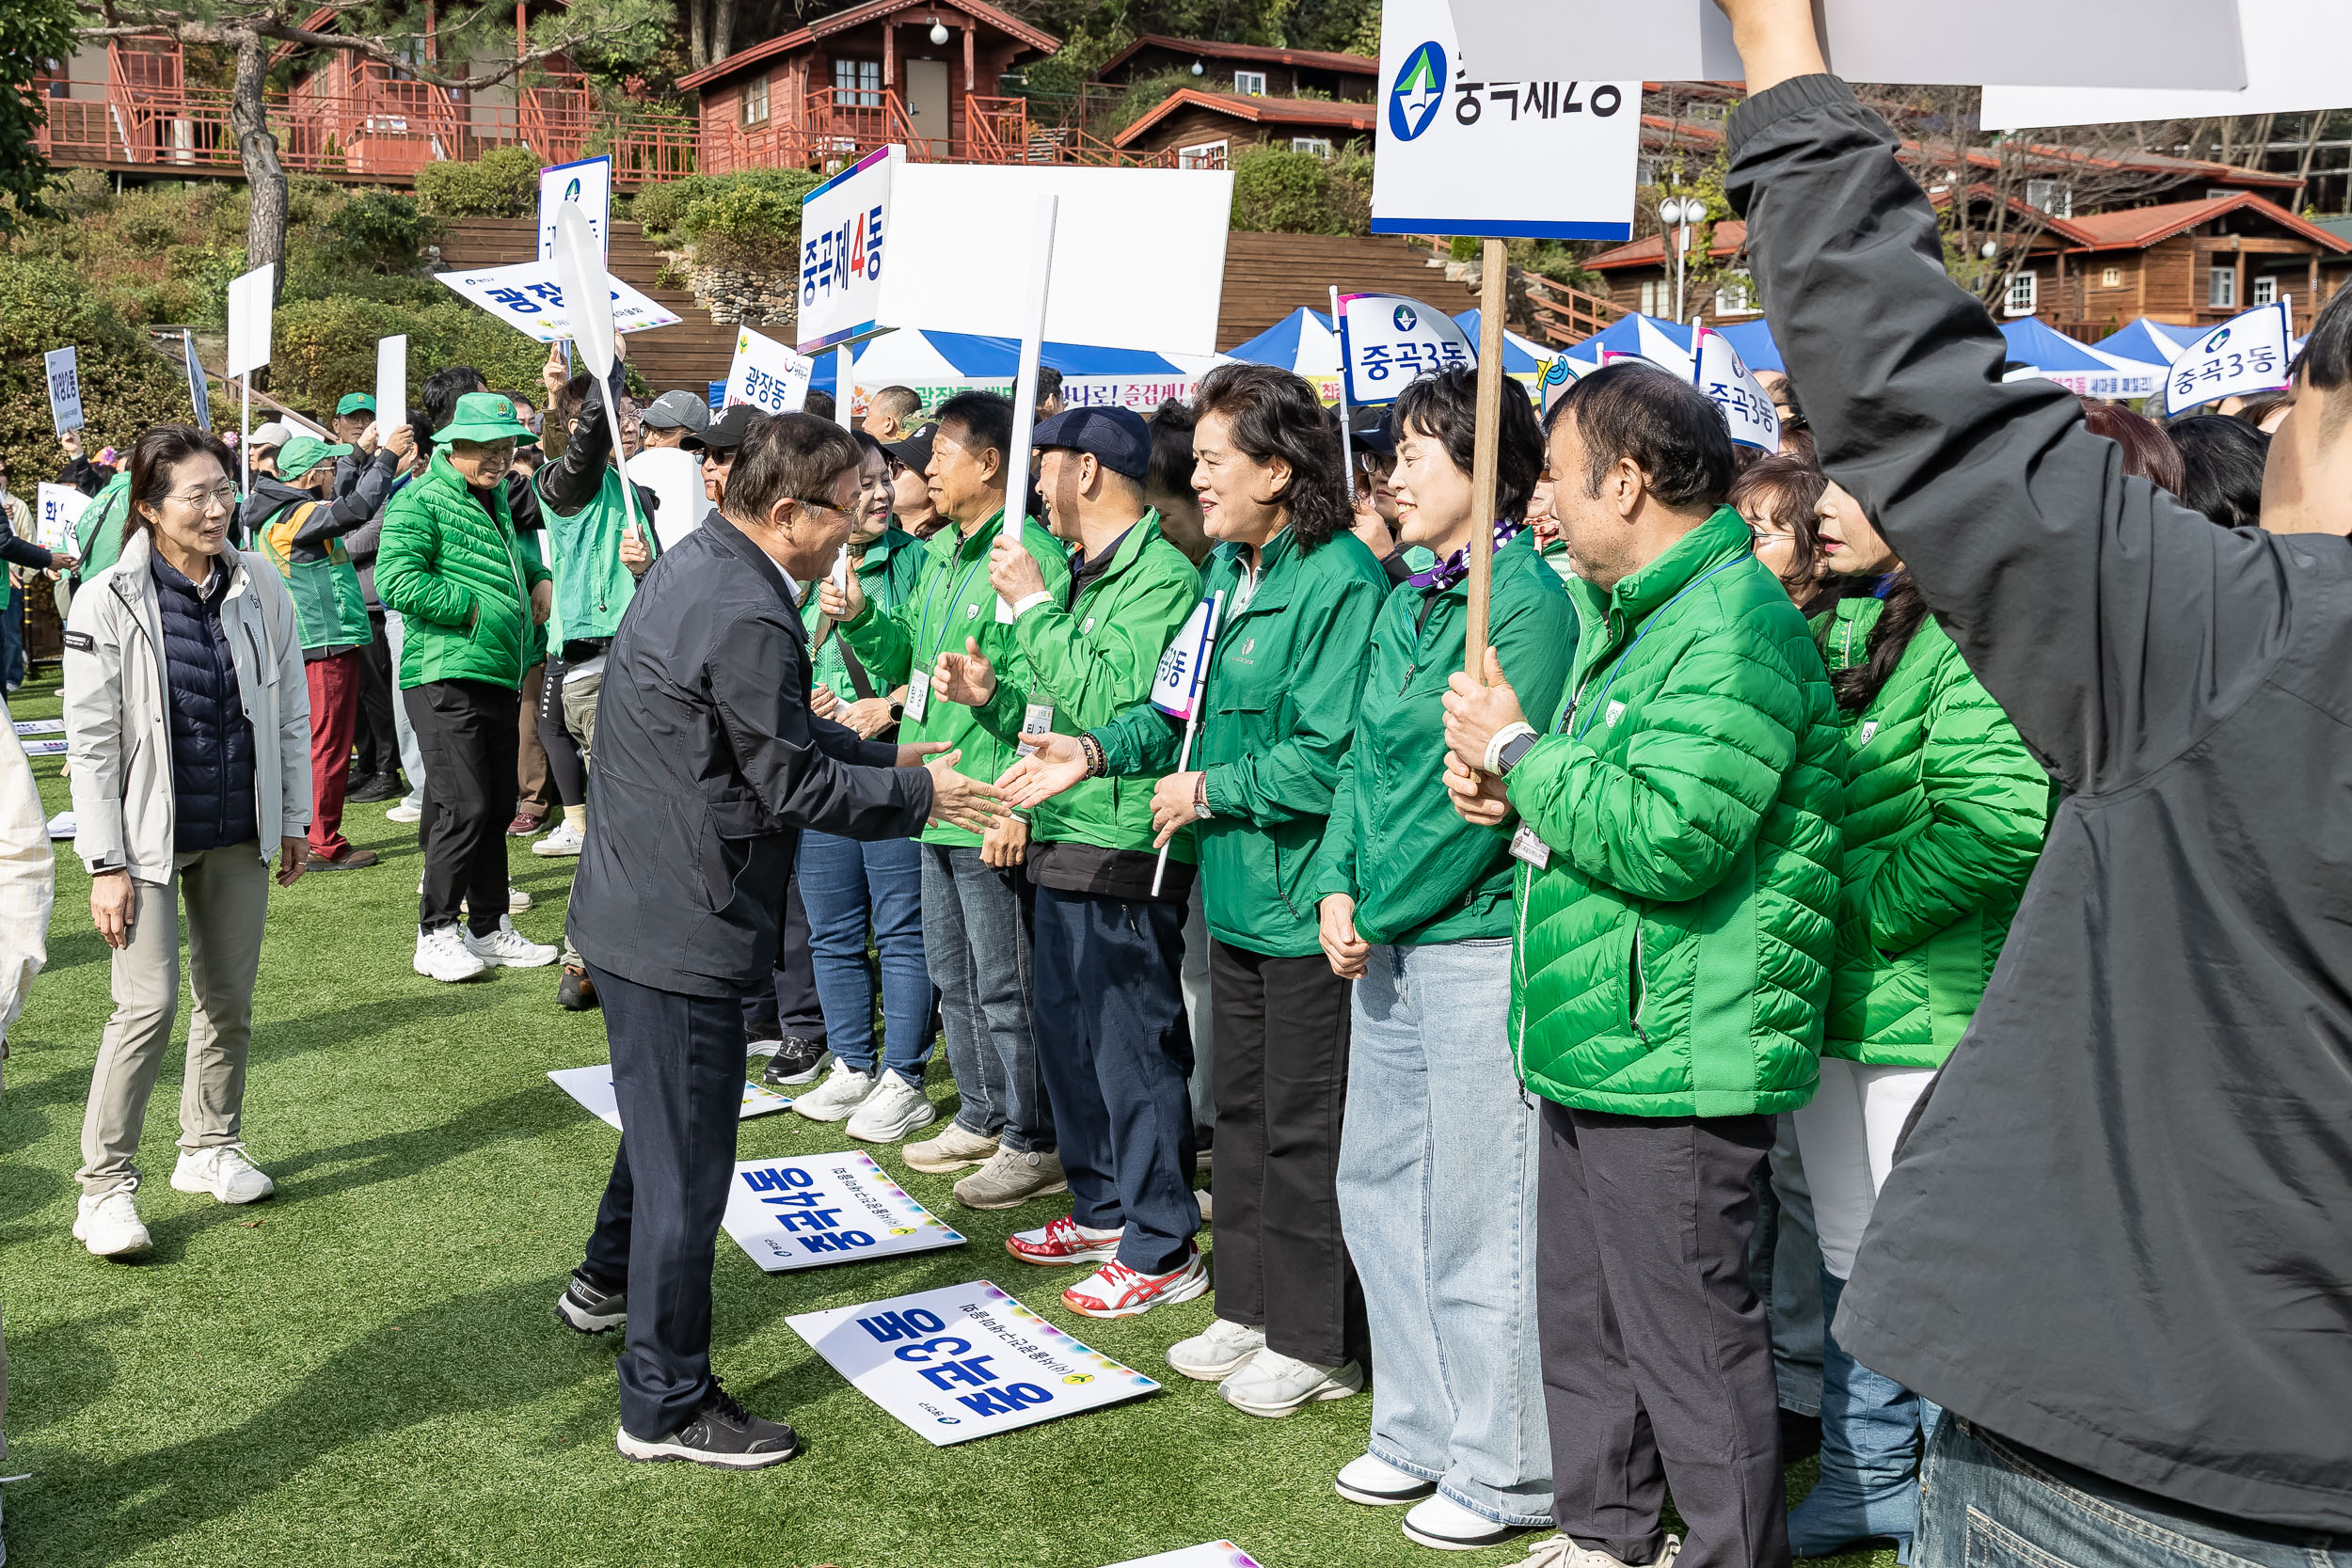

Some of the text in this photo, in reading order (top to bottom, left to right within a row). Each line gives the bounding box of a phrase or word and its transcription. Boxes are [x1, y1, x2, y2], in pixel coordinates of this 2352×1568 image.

[803, 204, 883, 308] 중곡제4동
[1360, 341, 1467, 381] 중곡3동
[2174, 345, 2278, 395] 중곡3동
[745, 366, 787, 410] 광장동
[1124, 383, 1184, 407] 즐겁게!
[740, 1167, 876, 1254] 중곡4동
[855, 1307, 1055, 1418] 중곡3동
